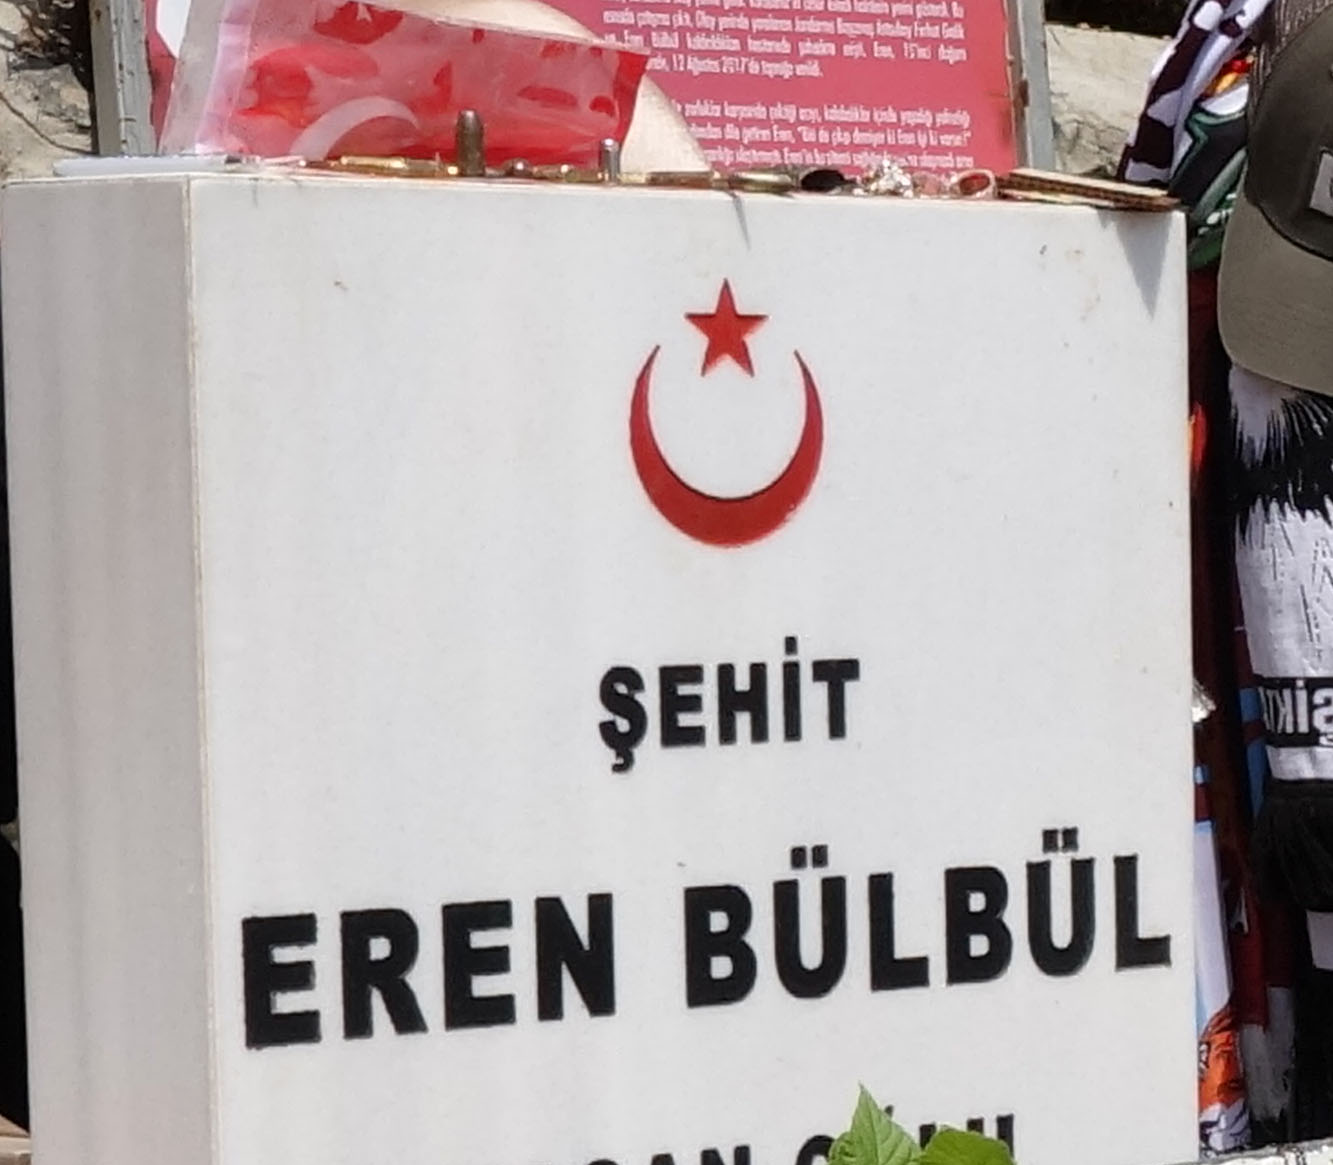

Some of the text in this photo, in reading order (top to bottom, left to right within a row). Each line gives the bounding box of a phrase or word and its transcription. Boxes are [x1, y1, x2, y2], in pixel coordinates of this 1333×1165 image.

[599, 636, 861, 774] ŞEHİT
[242, 828, 1170, 1049] EREN BÜLBÜL
